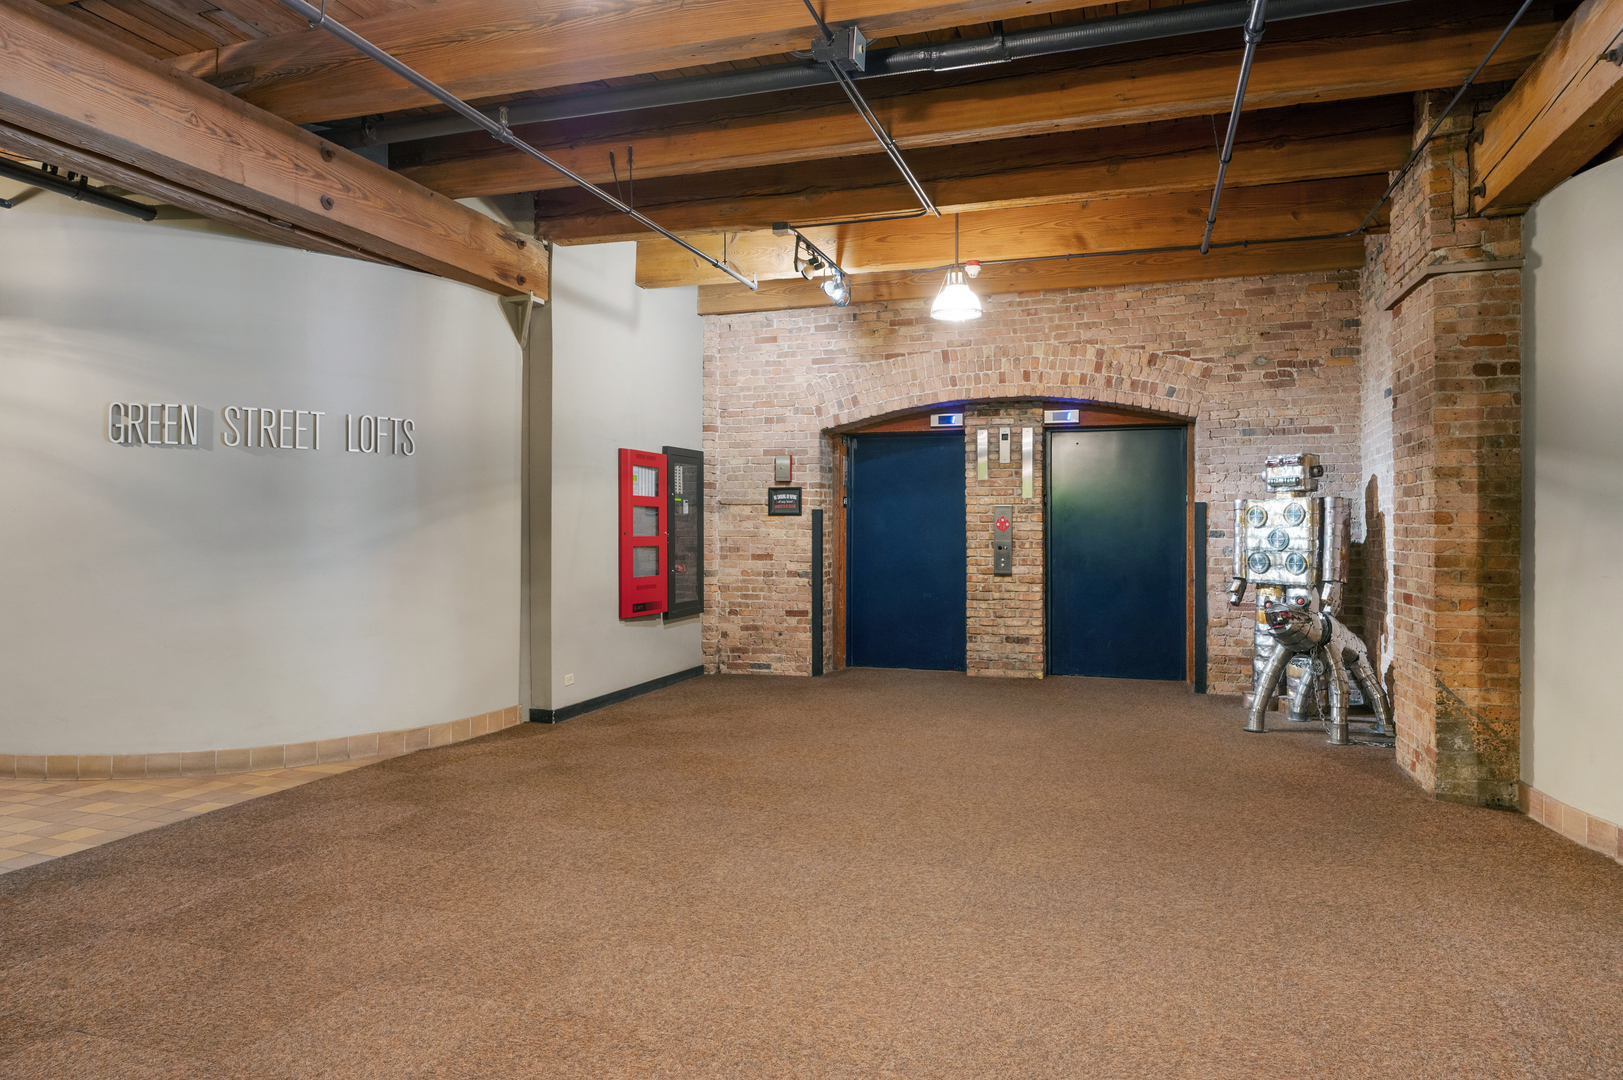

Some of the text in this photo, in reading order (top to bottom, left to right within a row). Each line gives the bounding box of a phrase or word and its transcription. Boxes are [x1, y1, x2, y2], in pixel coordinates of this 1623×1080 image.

[107, 401, 416, 456] GREEN STREET LOFTS
